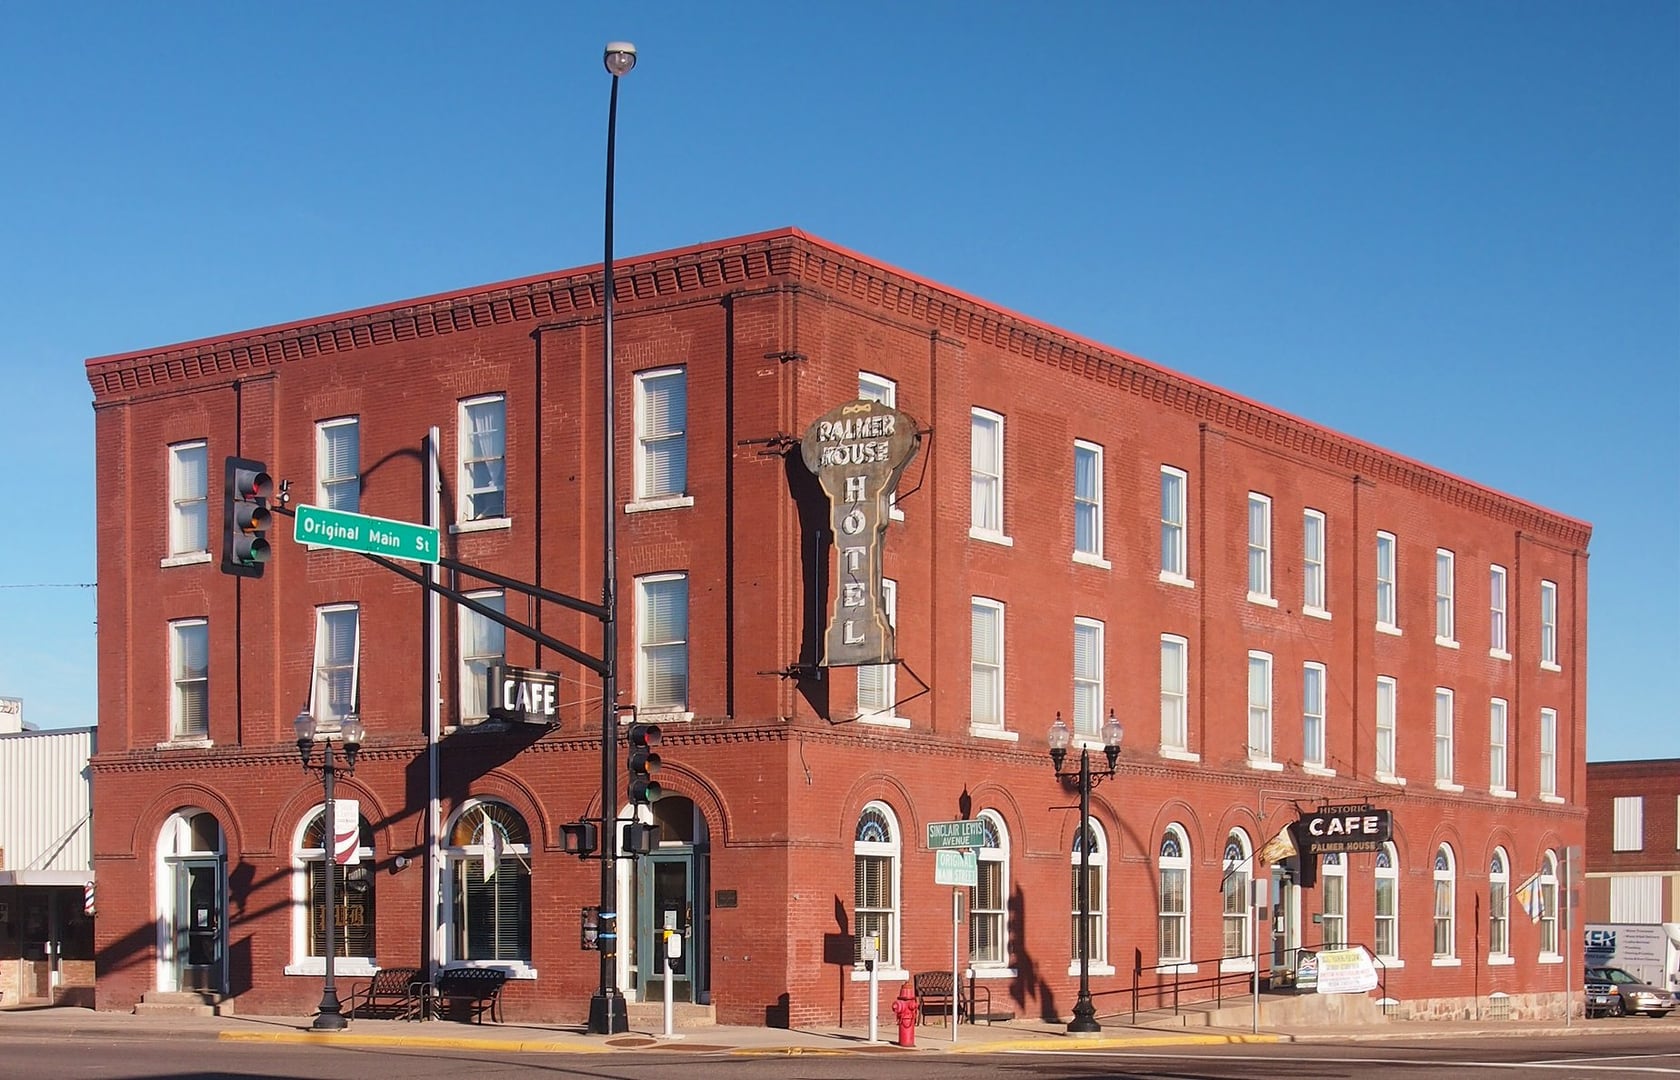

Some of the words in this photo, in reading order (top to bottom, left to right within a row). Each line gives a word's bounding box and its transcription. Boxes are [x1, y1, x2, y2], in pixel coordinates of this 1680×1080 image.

[818, 415, 895, 442] PALMER
[820, 441, 889, 466] HOUSE
[304, 517, 359, 541] Original
[369, 529, 400, 547] Main
[416, 536, 430, 552] St
[842, 475, 867, 646] HOTEL
[504, 680, 555, 715] CAFE
[1320, 805, 1368, 814] HISTORIC
[930, 823, 960, 837] SINCLAIR
[962, 822, 983, 836] LEWIS
[1309, 816, 1379, 836] CAFE
[942, 836, 970, 846] AVENUE
[1311, 843, 1344, 852] PALMER
[1346, 842, 1376, 851] HOUSE
